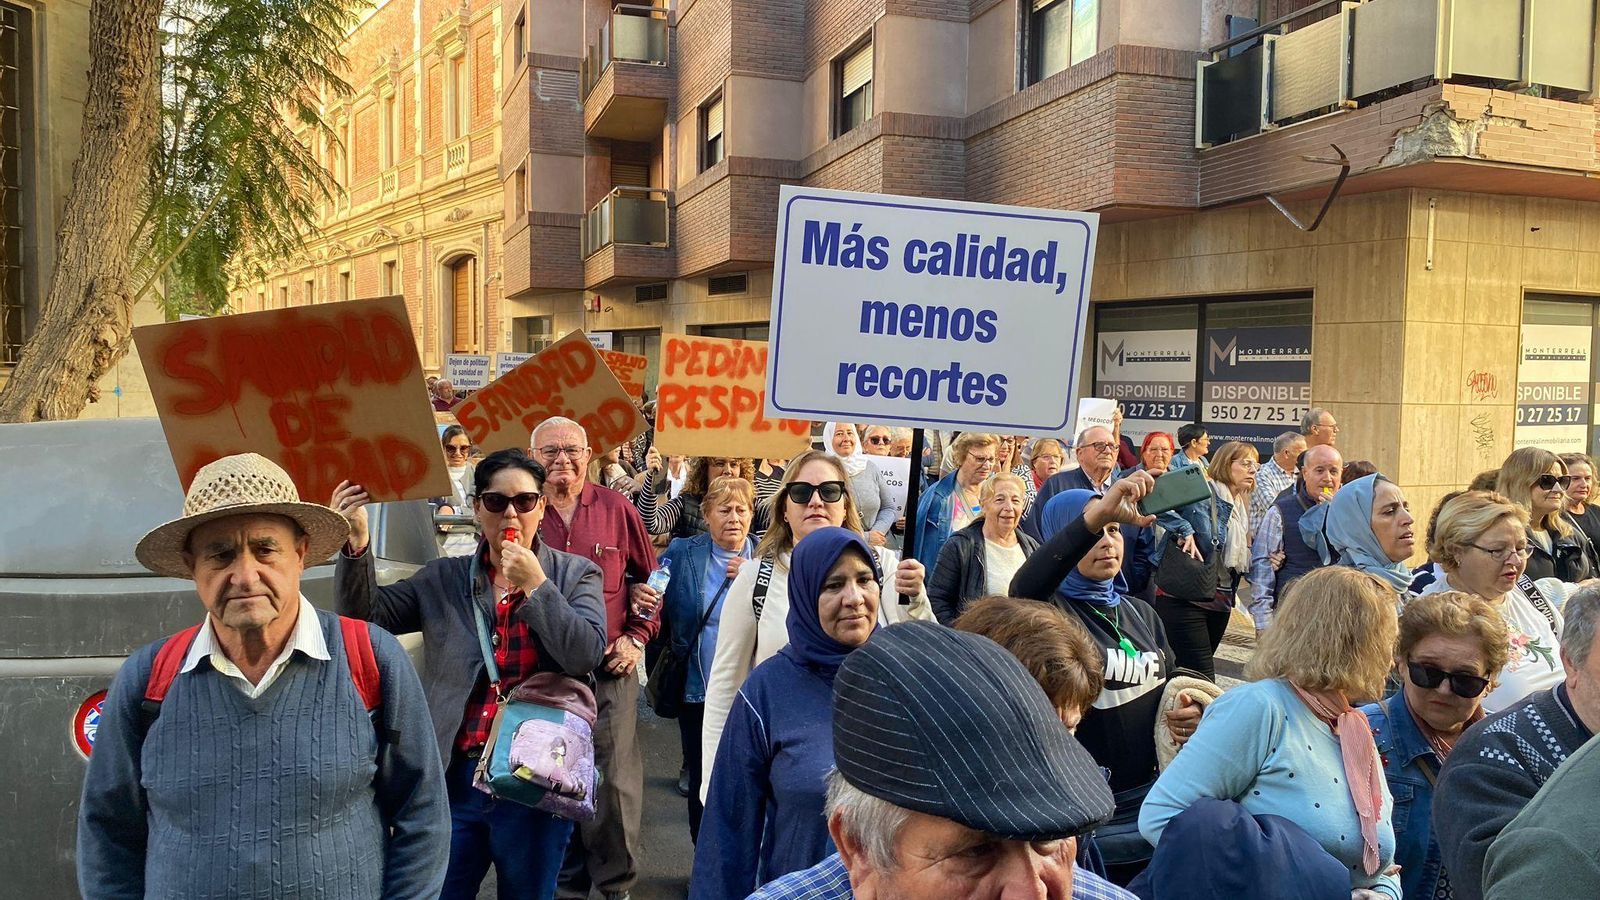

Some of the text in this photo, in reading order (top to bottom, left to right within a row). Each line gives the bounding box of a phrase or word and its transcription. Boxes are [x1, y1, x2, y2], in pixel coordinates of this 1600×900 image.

[801, 219, 1068, 295] Más calidad,
[859, 300, 998, 344] menos
[458, 368, 476, 376] sanidad
[836, 361, 1008, 407] recortes
[1103, 384, 1186, 399] DISPONIBLE
[456, 340, 597, 445] SANIDAD
[1211, 385, 1311, 401] DISPONIBLE
[1518, 386, 1582, 401] SPONIBLE
[1129, 403, 1146, 417] 27
[1149, 404, 1165, 418] 25
[1169, 404, 1186, 418] 17
[1211, 405, 1238, 420] 950
[1243, 406, 1262, 421] 27
[1266, 407, 1285, 421] 25
[1527, 407, 1544, 422] 27
[1547, 407, 1562, 422] 25
[1566, 407, 1582, 422] 17
[268, 395, 351, 448] DE
[1104, 647, 1160, 685] NIKE
